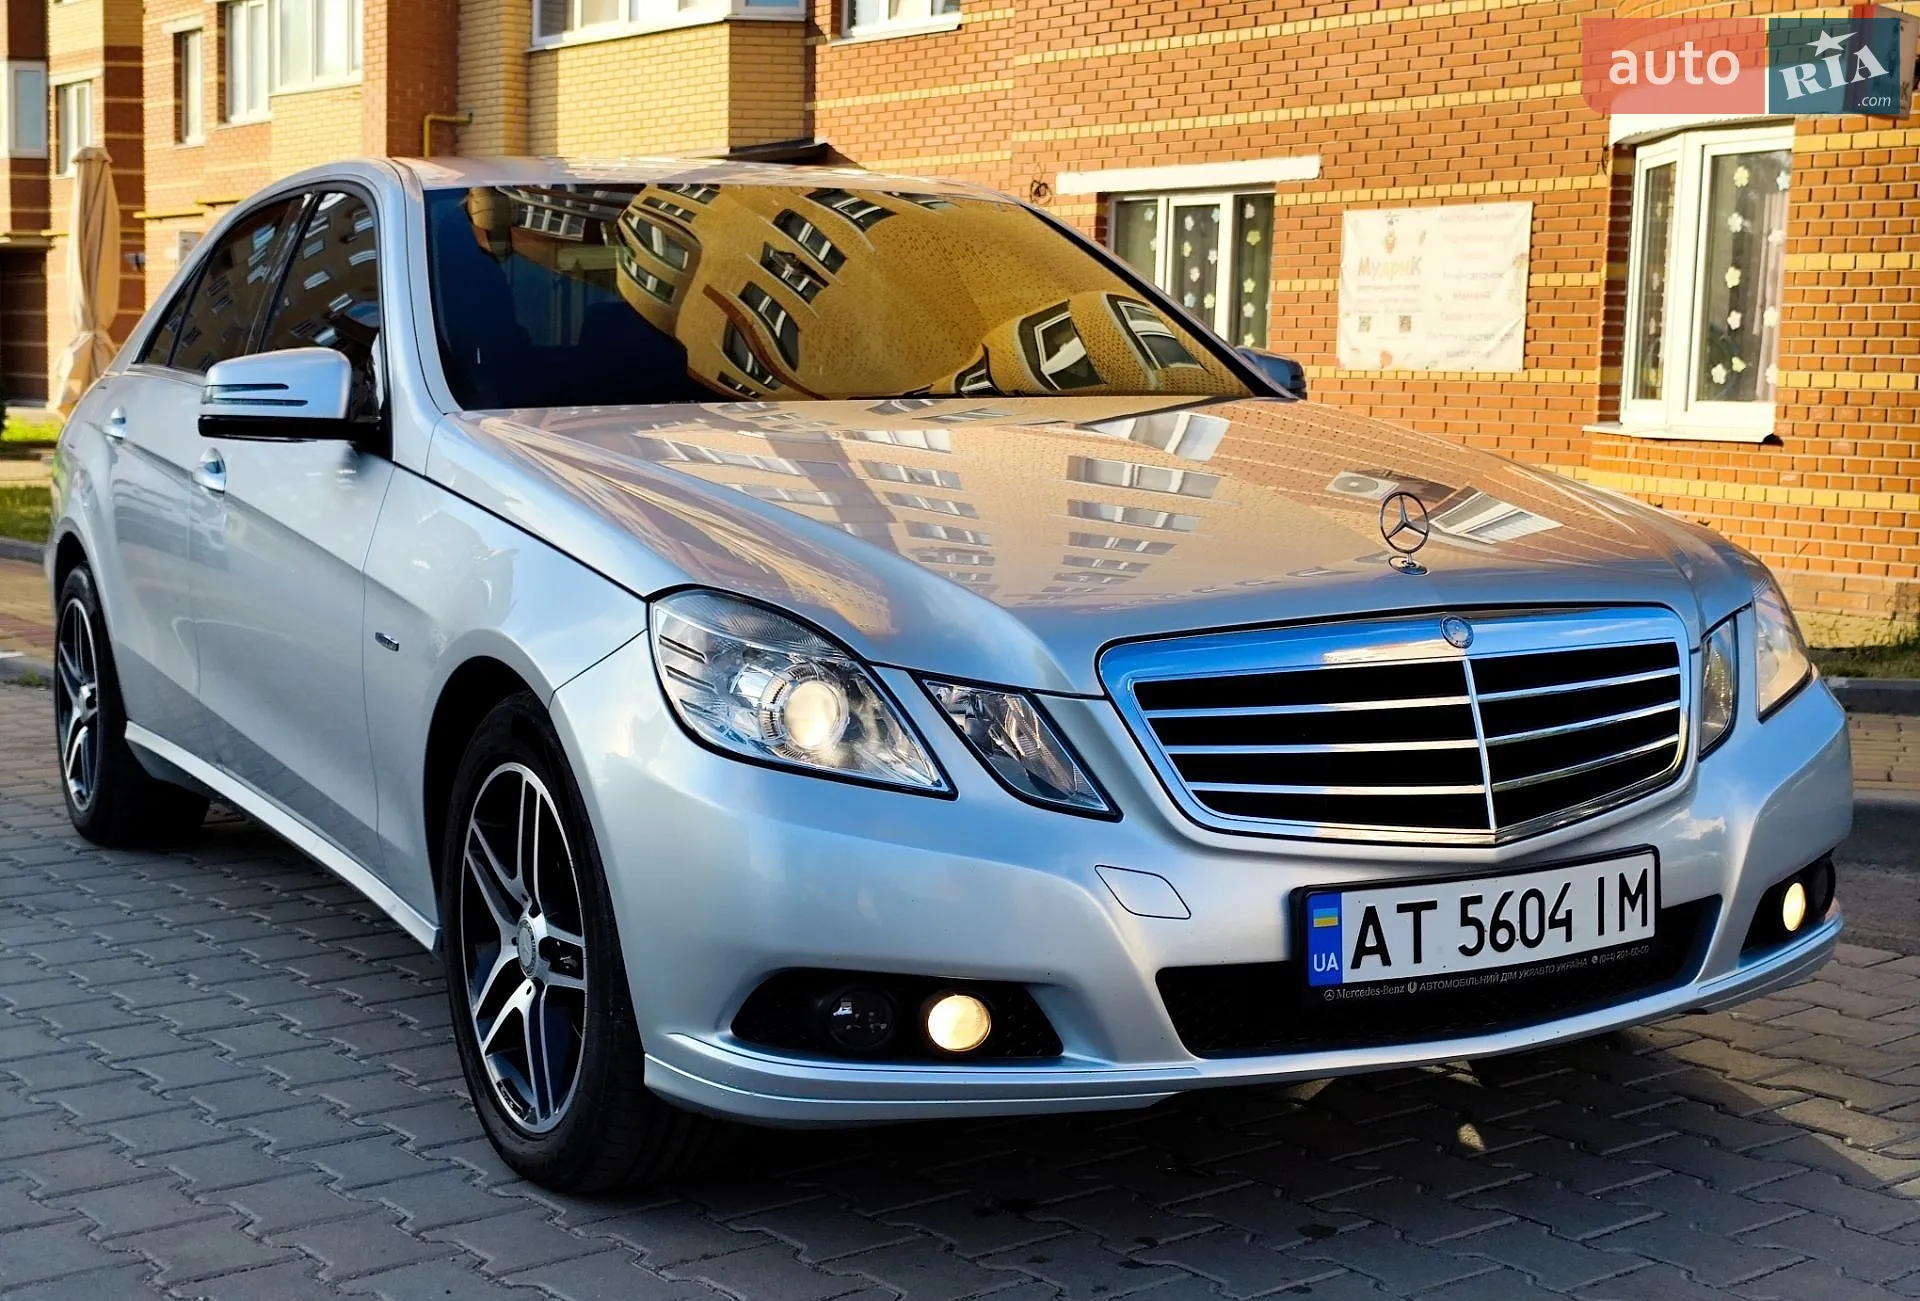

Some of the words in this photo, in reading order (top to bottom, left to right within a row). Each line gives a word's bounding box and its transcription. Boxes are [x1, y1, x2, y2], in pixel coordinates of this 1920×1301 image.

[1350, 900, 1438, 970] AT
[1458, 882, 1573, 957] 5604
[1313, 952, 1339, 972] UA
[1419, 973, 1500, 992] АВТОМОБІЛЬНИЙ
[1500, 971, 1518, 984] ДІМ
[1518, 965, 1555, 980] УКРАВТО
[1336, 985, 1405, 1000] Mercedes-Benz
